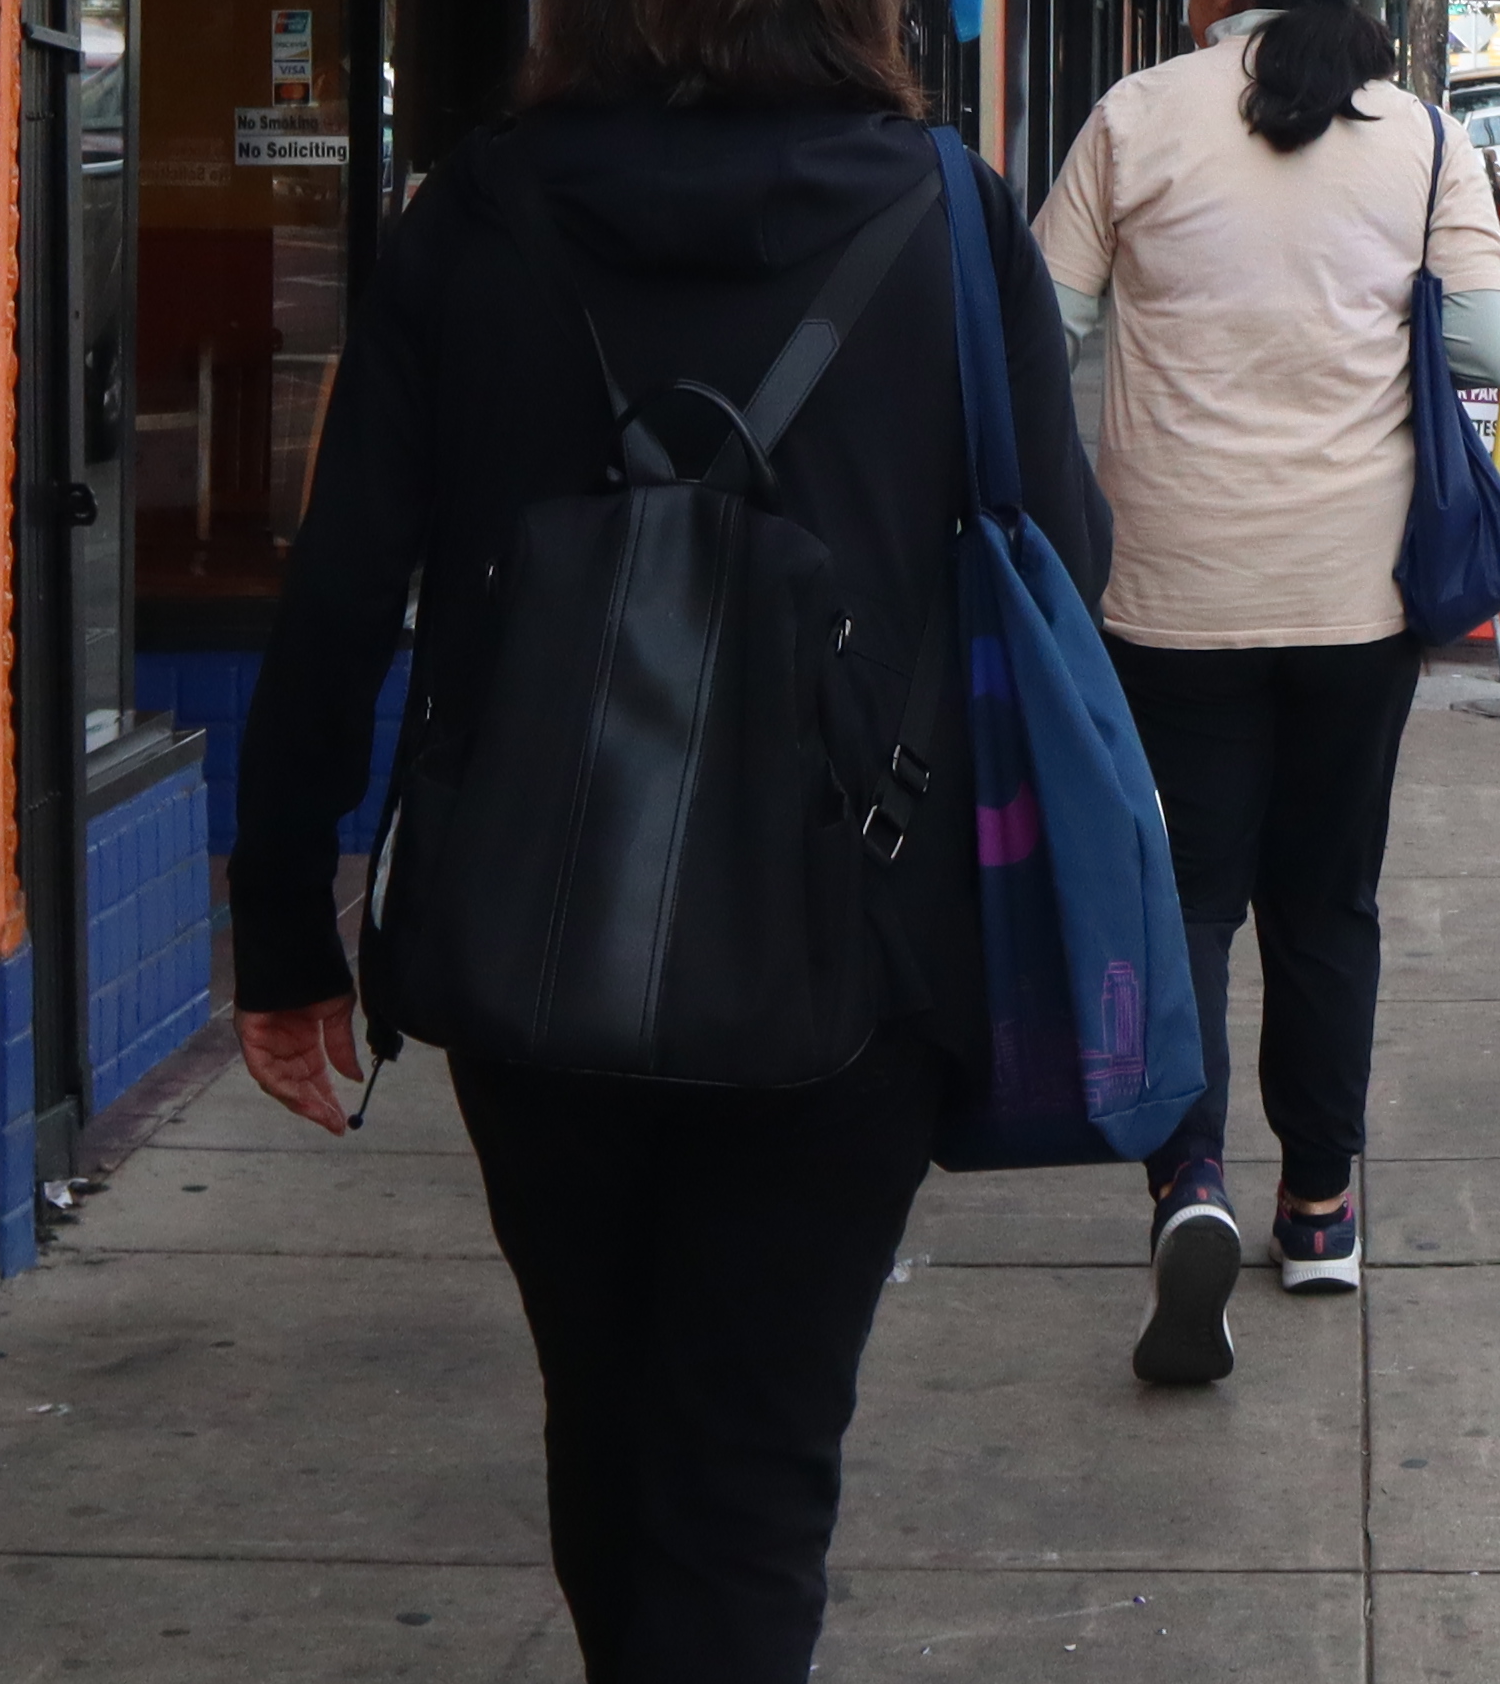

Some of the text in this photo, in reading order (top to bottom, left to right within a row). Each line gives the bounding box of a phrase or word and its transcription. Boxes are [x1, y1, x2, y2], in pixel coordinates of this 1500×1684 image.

[280, 65, 306, 76] VISA
[237, 115, 318, 133] No Smoking
[238, 141, 347, 161] No Soliciting
